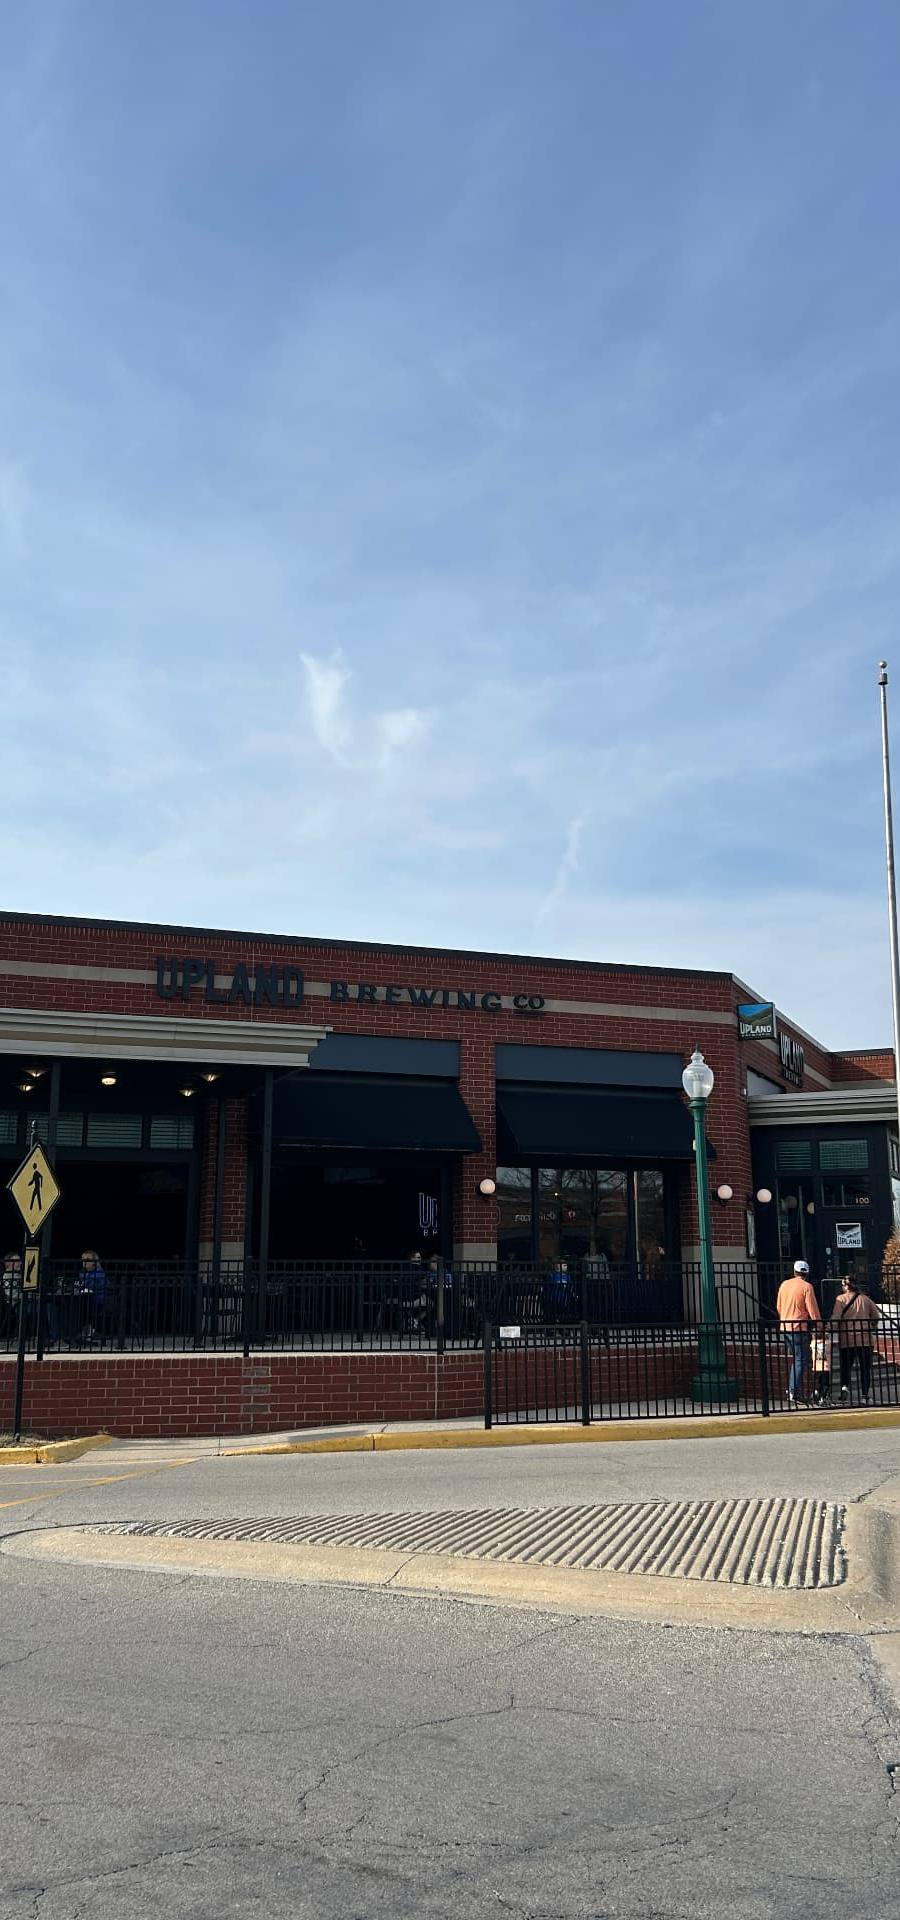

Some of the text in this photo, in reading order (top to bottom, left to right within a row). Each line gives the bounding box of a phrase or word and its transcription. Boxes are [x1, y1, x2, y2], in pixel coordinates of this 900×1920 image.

[156, 957, 545, 1015] UPLAND BREWING CO
[740, 1022, 772, 1034] UPLAND
[780, 1031, 804, 1074] UPLAND
[838, 1236, 861, 1244] UPLAND
